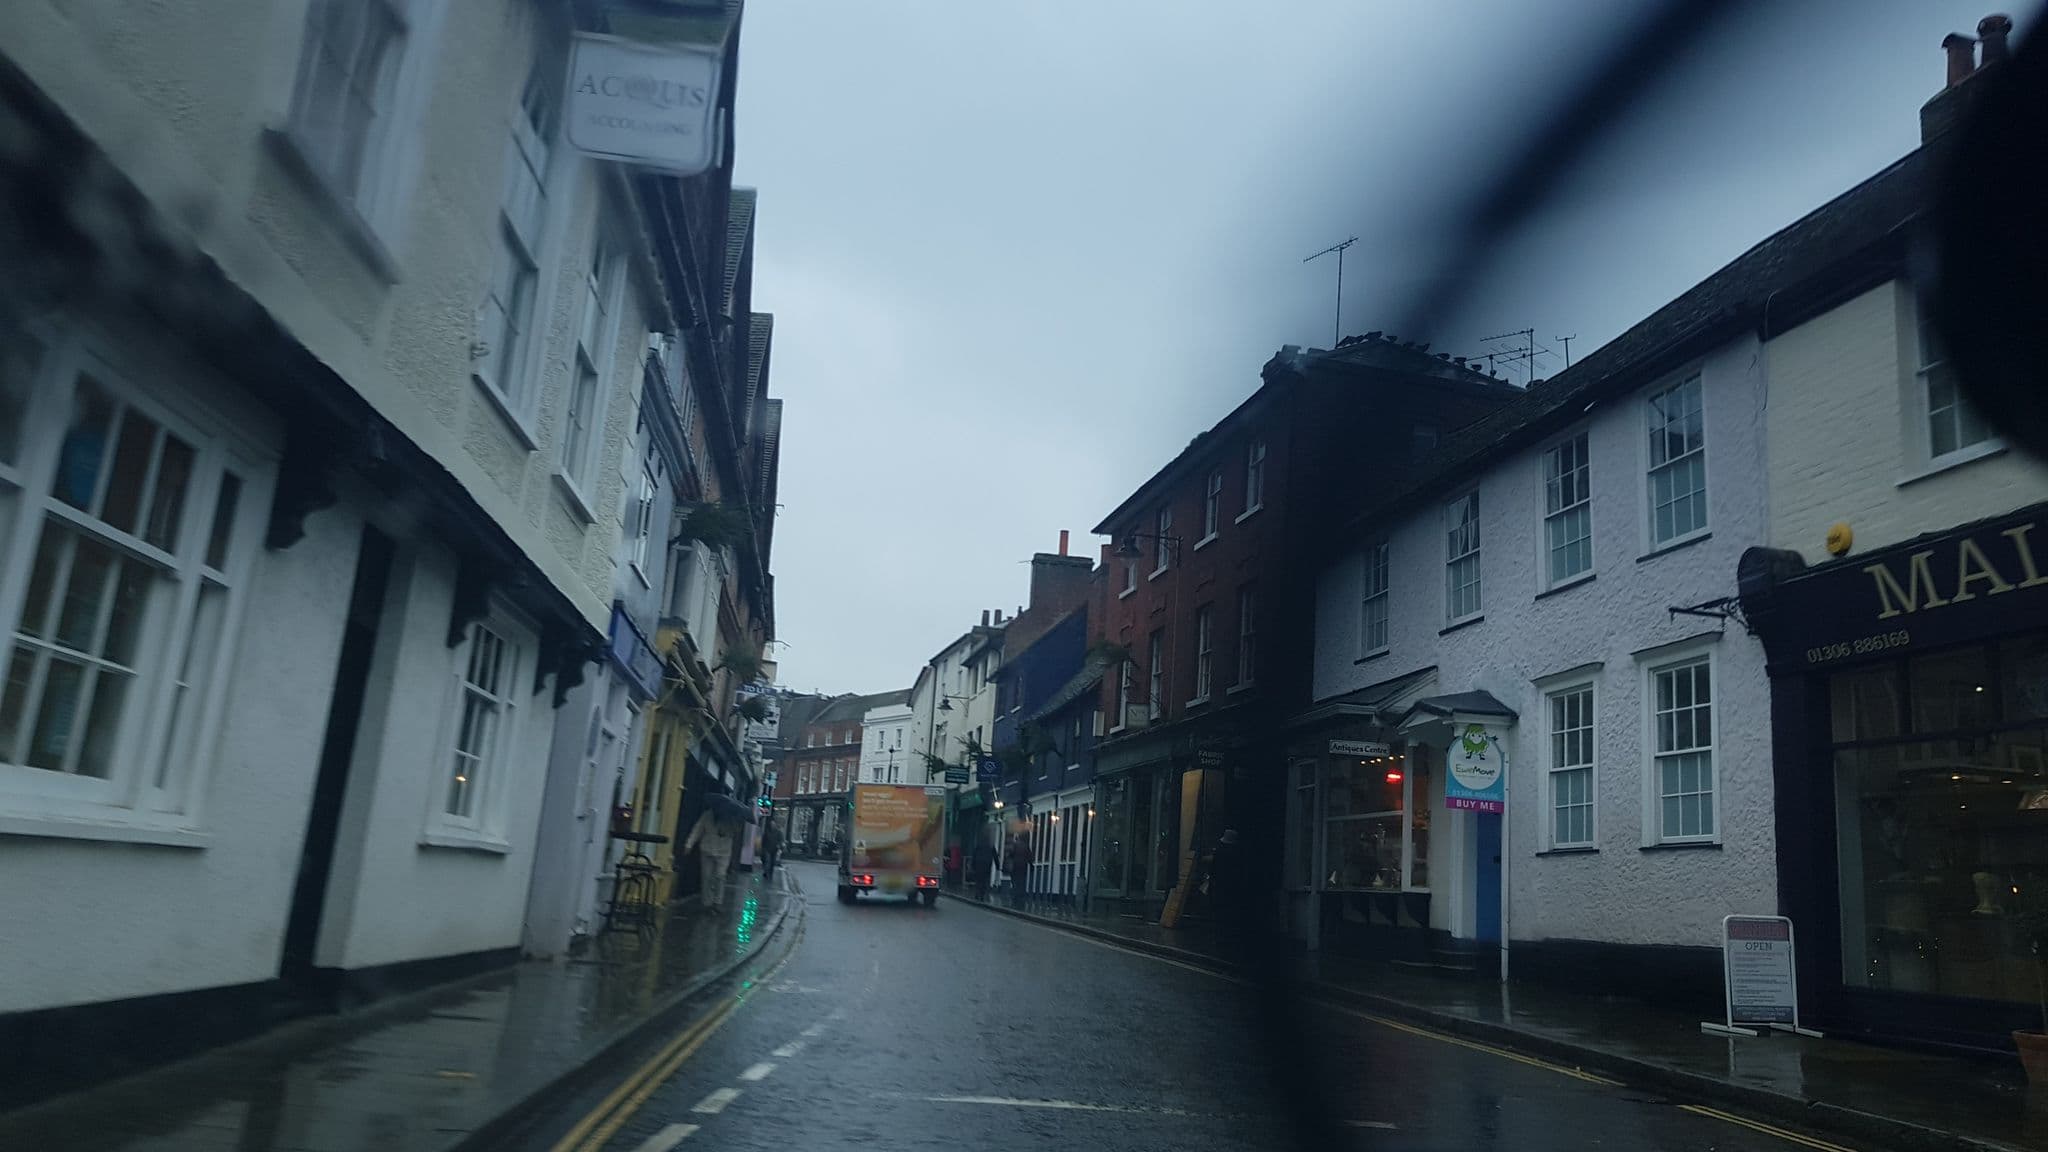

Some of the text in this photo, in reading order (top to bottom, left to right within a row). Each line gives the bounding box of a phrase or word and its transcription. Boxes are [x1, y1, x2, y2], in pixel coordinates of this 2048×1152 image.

[1807, 642, 1851, 663] 01306
[1332, 743, 1388, 754] Antiques Centre
[1456, 799, 1495, 811] BUY ME
[1744, 942, 1773, 951] OPEN
